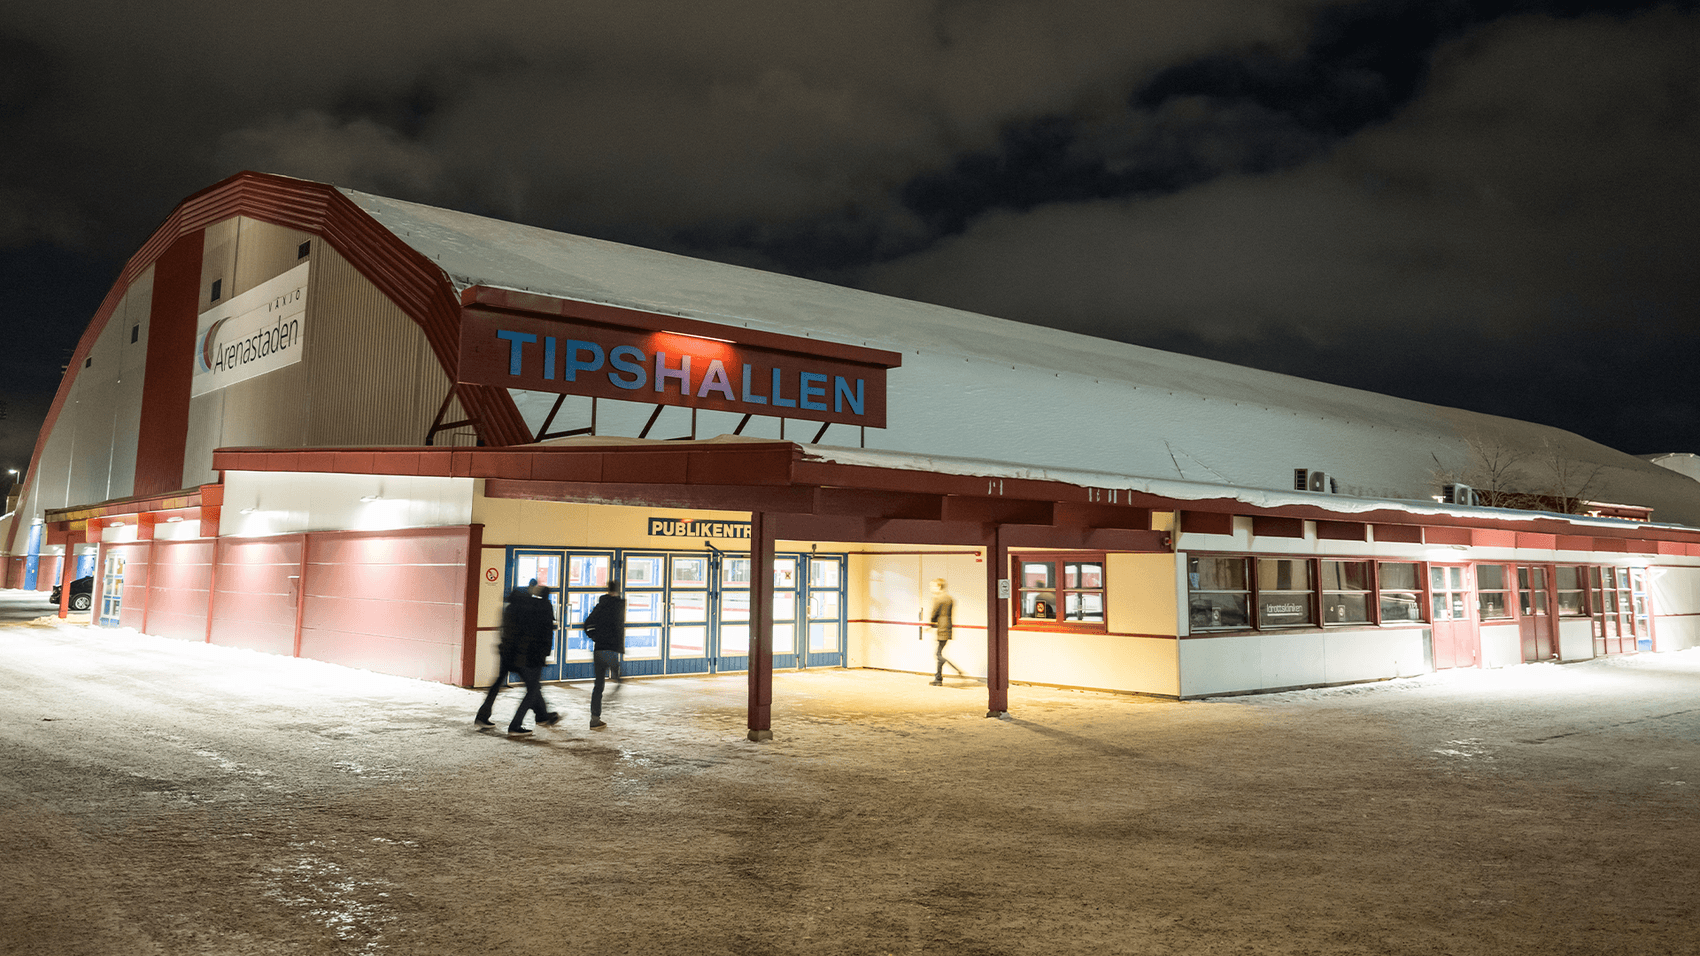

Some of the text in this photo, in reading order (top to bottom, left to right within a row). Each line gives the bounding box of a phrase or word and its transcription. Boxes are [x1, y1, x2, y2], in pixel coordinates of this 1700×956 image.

[213, 315, 299, 375] Arenastaden
[496, 329, 865, 416] TIPSHALLEN
[651, 521, 752, 538] PUBLIKENTR
